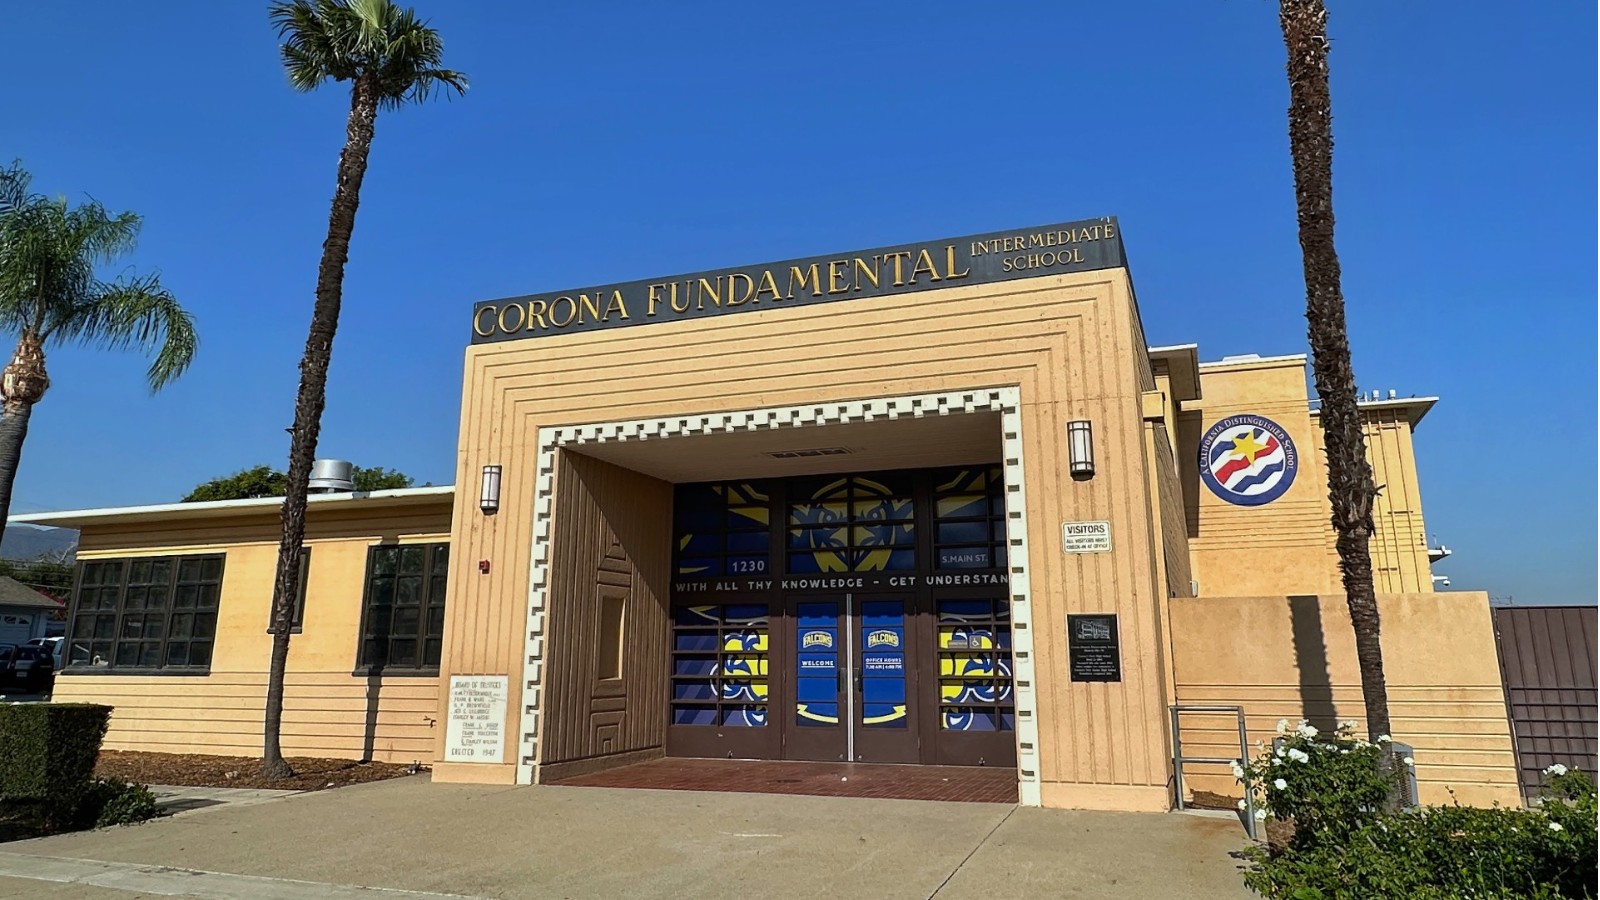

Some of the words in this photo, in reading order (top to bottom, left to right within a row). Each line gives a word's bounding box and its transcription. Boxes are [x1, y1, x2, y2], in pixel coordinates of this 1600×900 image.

[970, 223, 1115, 257] INTERMEDIATE
[1002, 248, 1085, 272] SCHOOL
[473, 289, 630, 337] CORONA
[646, 245, 971, 316] FUNDAMENTAL
[1200, 425, 1226, 467] CALIFORNIA
[1224, 416, 1285, 440] DISTINGUISHED
[1281, 439, 1294, 470] SCHOOL
[1067, 524, 1105, 534] VISITORS
[975, 554, 988, 562] ST.
[732, 560, 765, 572] 1230
[676, 582, 707, 592] WITH
[716, 581, 739, 591] ALL
[748, 580, 773, 590] THY
[781, 578, 863, 589] KNOWLEDGE
[889, 576, 916, 586] GET
[804, 633, 832, 647] FALCONS
[868, 632, 898, 647] FALCONS
[455, 681, 470, 689] BOARD
[472, 681, 478, 689] OF
[451, 748, 475, 756] ERECTED
